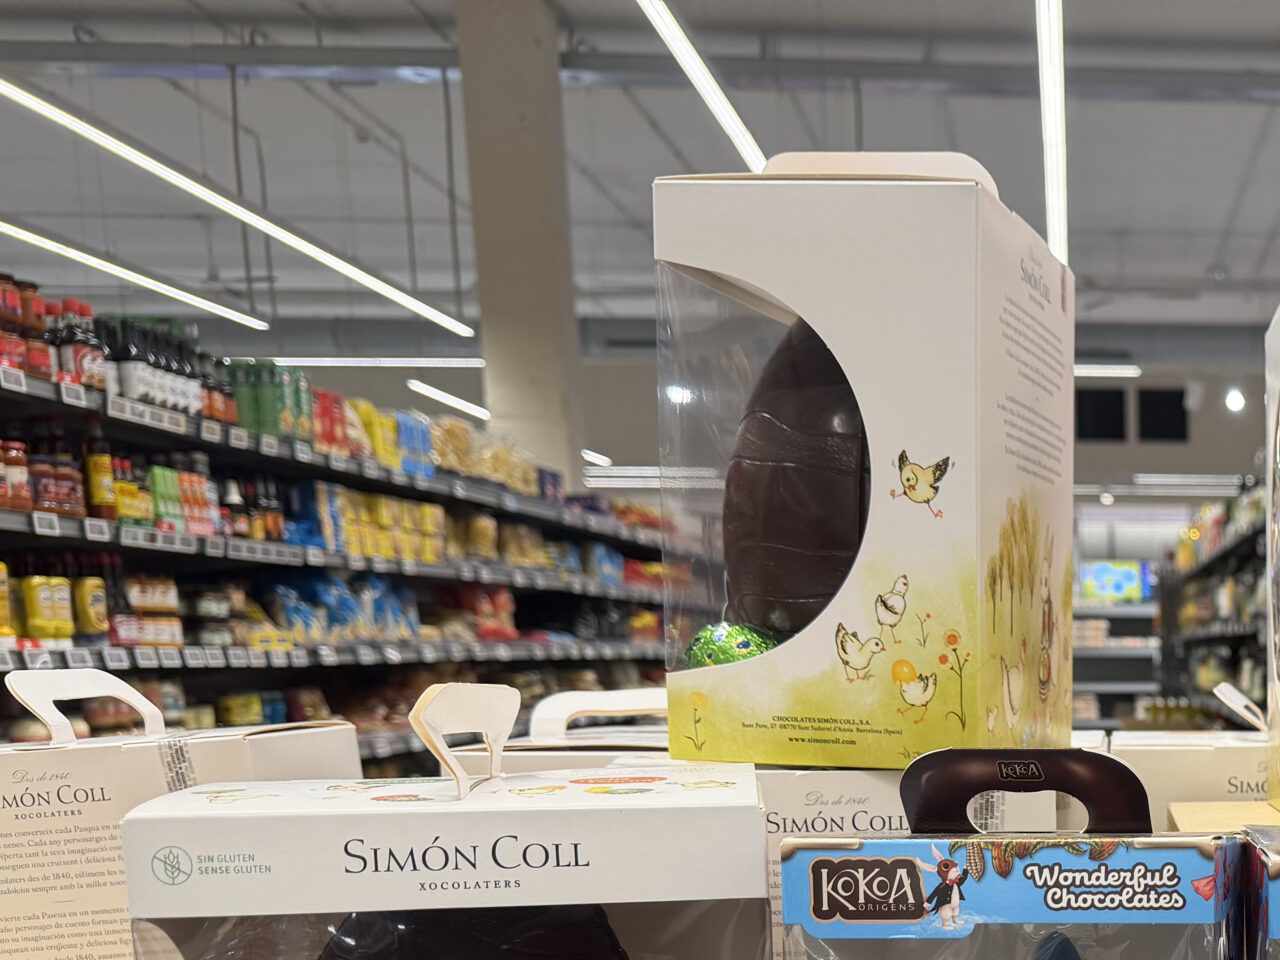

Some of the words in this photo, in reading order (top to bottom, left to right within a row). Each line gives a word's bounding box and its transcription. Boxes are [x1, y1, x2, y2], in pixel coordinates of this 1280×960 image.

[772, 715, 816, 724] CHOCOLATES
[788, 736, 856, 745] www.simoncoll.com
[0, 787, 51, 809] MÓN
[57, 785, 111, 804] COLL
[14, 809, 82, 820] XOCOLATERS
[766, 811, 844, 833] SIMÓN
[852, 810, 909, 832] COLL
[55, 826, 72, 834] cada
[74, 824, 100, 834] Pasqua
[27, 839, 47, 847] Cada
[197, 854, 213, 864] SIN
[217, 853, 255, 863] GLUTEN
[343, 836, 479, 874] SIMÓN
[491, 835, 590, 872] COLL
[198, 865, 230, 875] SENSE
[233, 864, 272, 875] GLUTEN
[1025, 864, 1179, 892] Wonderful
[419, 879, 522, 891] XOCOLATERS
[1046, 887, 1184, 909] Chocolates
[858, 903, 915, 911] ORIGENS
